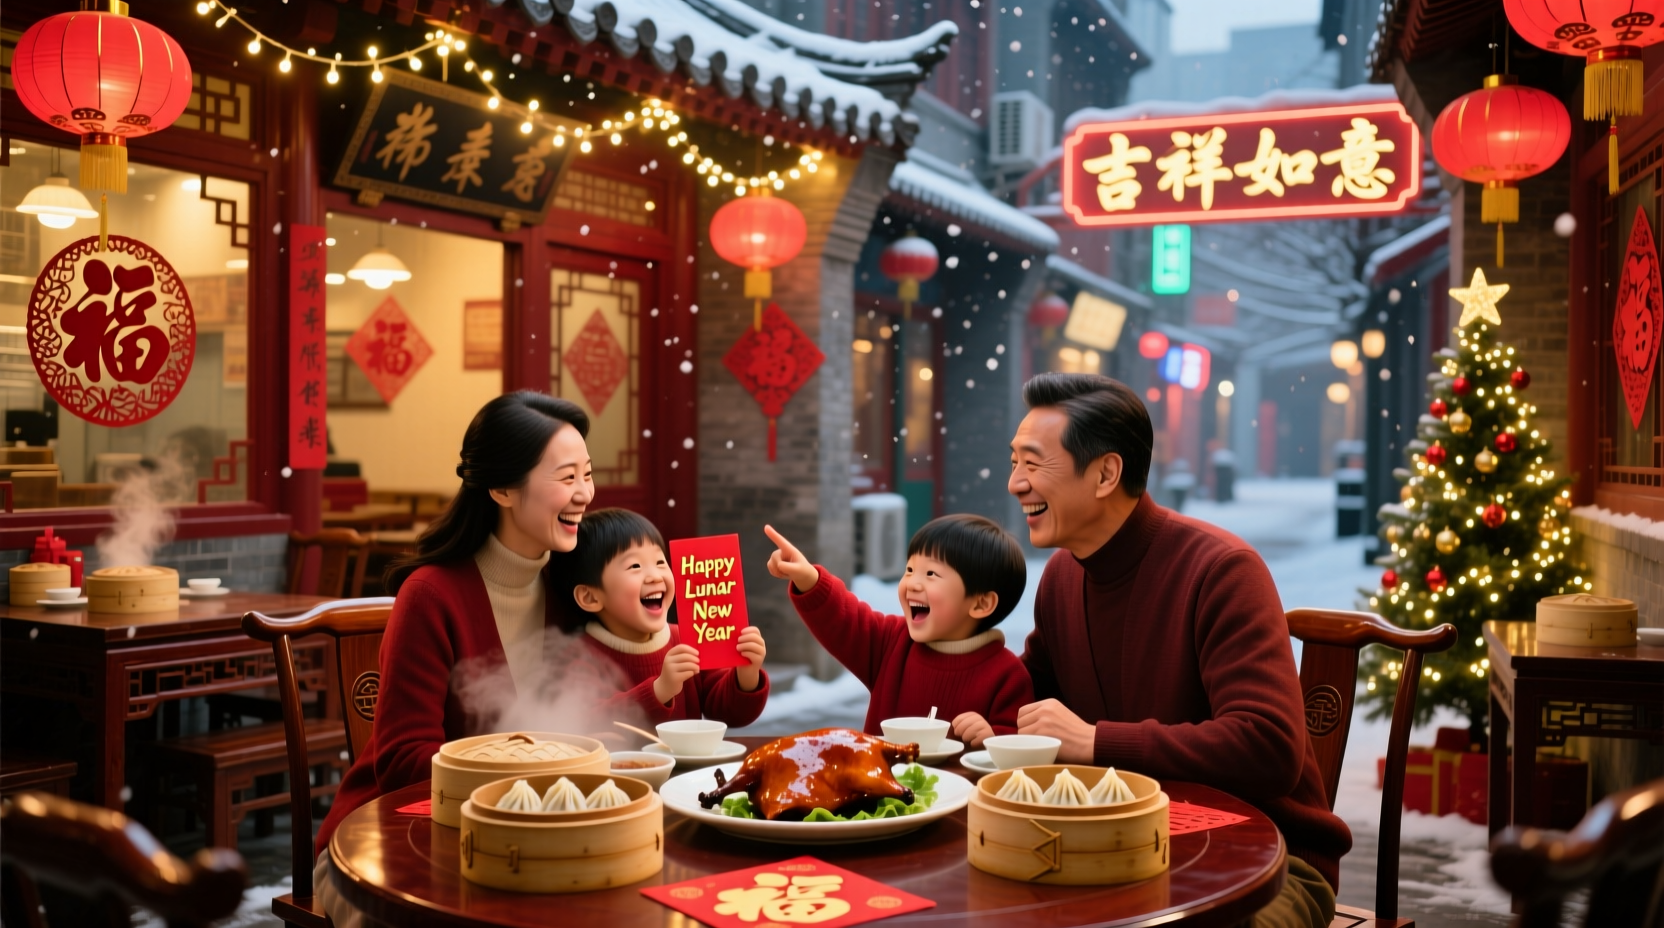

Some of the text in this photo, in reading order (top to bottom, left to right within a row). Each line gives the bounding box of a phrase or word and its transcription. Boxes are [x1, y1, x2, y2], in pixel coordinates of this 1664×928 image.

[1082, 117, 1396, 212] 吉祥如意
[60, 259, 171, 385] 福
[1620, 254, 1653, 371] 福
[365, 318, 413, 377] 福
[681, 554, 735, 579] Happy
[685, 579, 736, 599] Lunar
[693, 600, 733, 621] New
[693, 622, 735, 644] Year
[713, 872, 851, 923] 福
